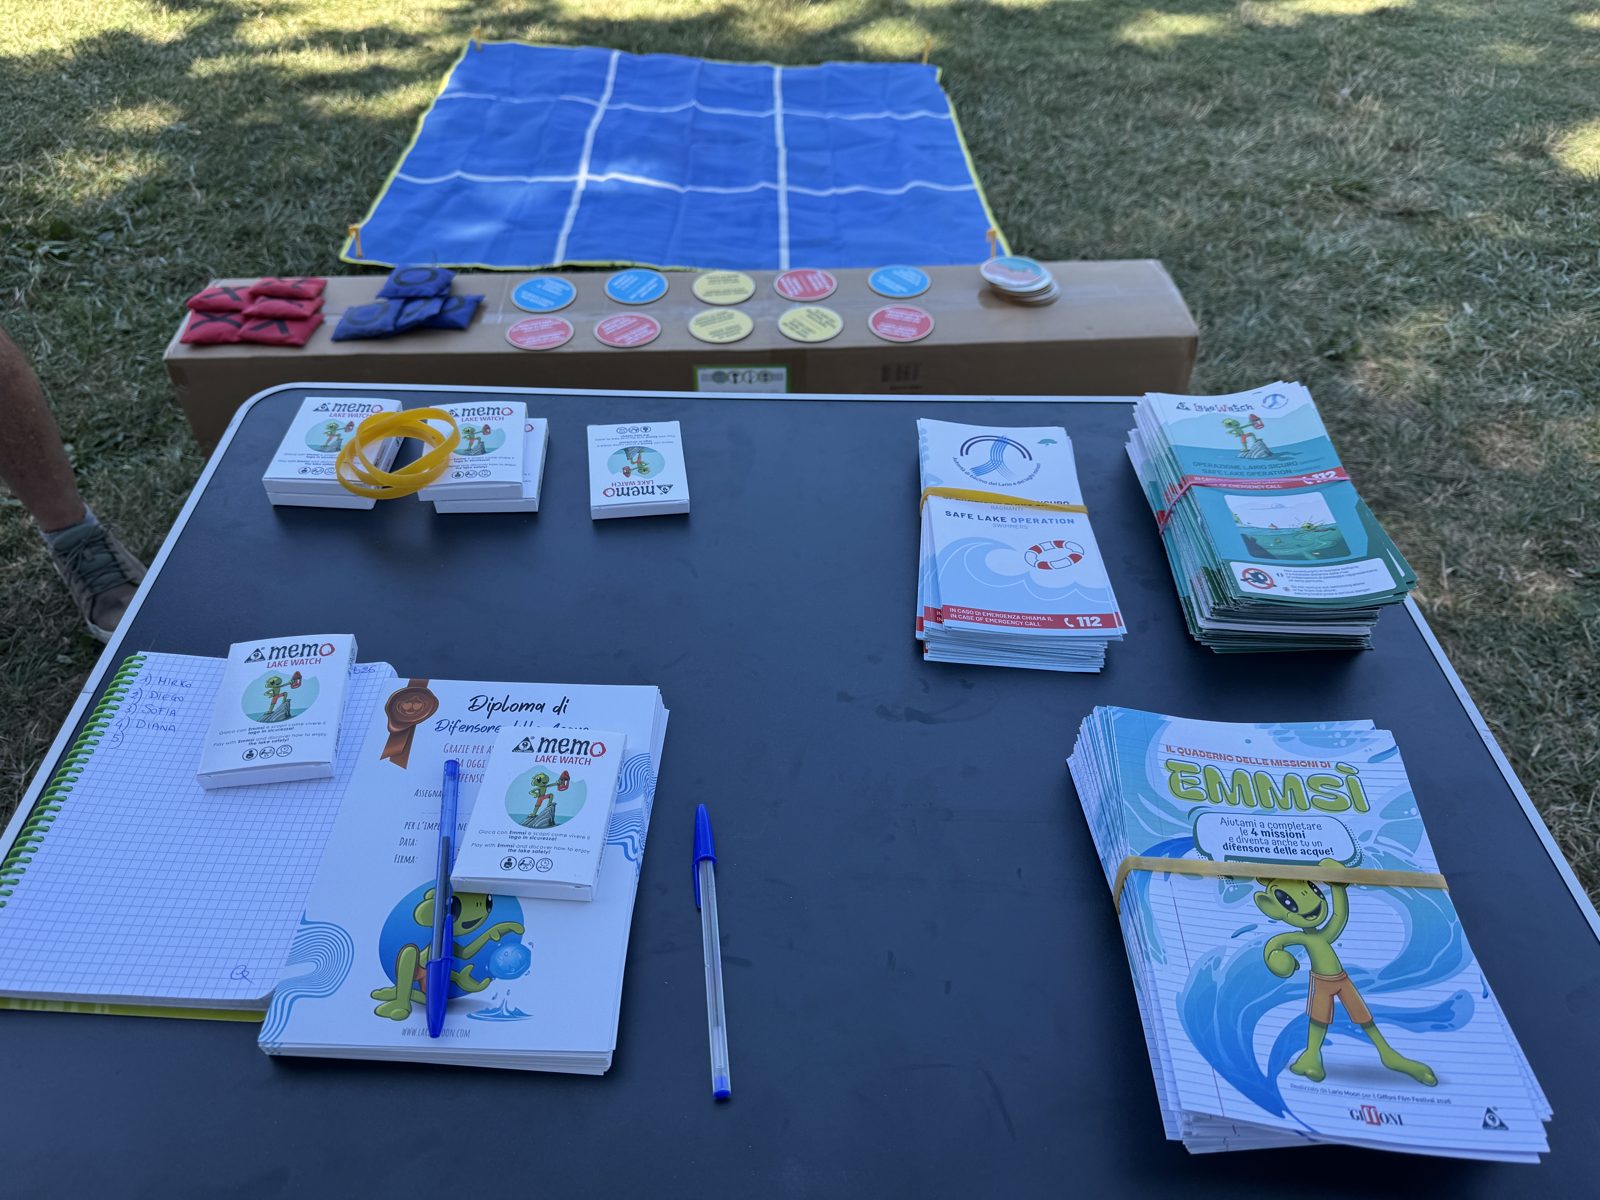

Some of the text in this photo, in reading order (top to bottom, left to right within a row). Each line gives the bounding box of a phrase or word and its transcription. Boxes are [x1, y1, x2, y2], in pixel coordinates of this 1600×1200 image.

[332, 402, 384, 413] memo
[461, 406, 514, 417] memo
[1246, 469, 1292, 477] OPERATION
[602, 485, 656, 498] memo
[945, 510, 1075, 525] SAFE LAKE OPERATION
[982, 611, 1021, 620] EMERGENZA
[985, 617, 1024, 626] EMERGENCY
[1076, 616, 1103, 627] 112
[268, 642, 336, 660] memo
[266, 658, 322, 668] LAKE WATCH
[149, 690, 184, 702] DIEGO
[141, 704, 176, 717] SOFIA
[468, 694, 570, 719] Diploma di
[136, 719, 176, 733] DIANA
[434, 718, 501, 736] Difensore
[443, 742, 470, 754] GRAZIE
[537, 736, 607, 758] memo
[534, 754, 592, 766] LAKE WATCH
[1166, 744, 1332, 769] IL QUADERNO DELLE MISSIONI DI
[466, 759, 486, 768] OGGI
[1165, 759, 1371, 814] EMMSÌ
[404, 821, 416, 830] PER
[1220, 817, 1258, 828] Aiutami
[1268, 822, 1322, 832] completare
[1240, 826, 1306, 840] le 4 missioni
[1236, 836, 1270, 846] diventa
[1272, 838, 1298, 847] anche
[1222, 842, 1335, 858] difensore delle acque!
